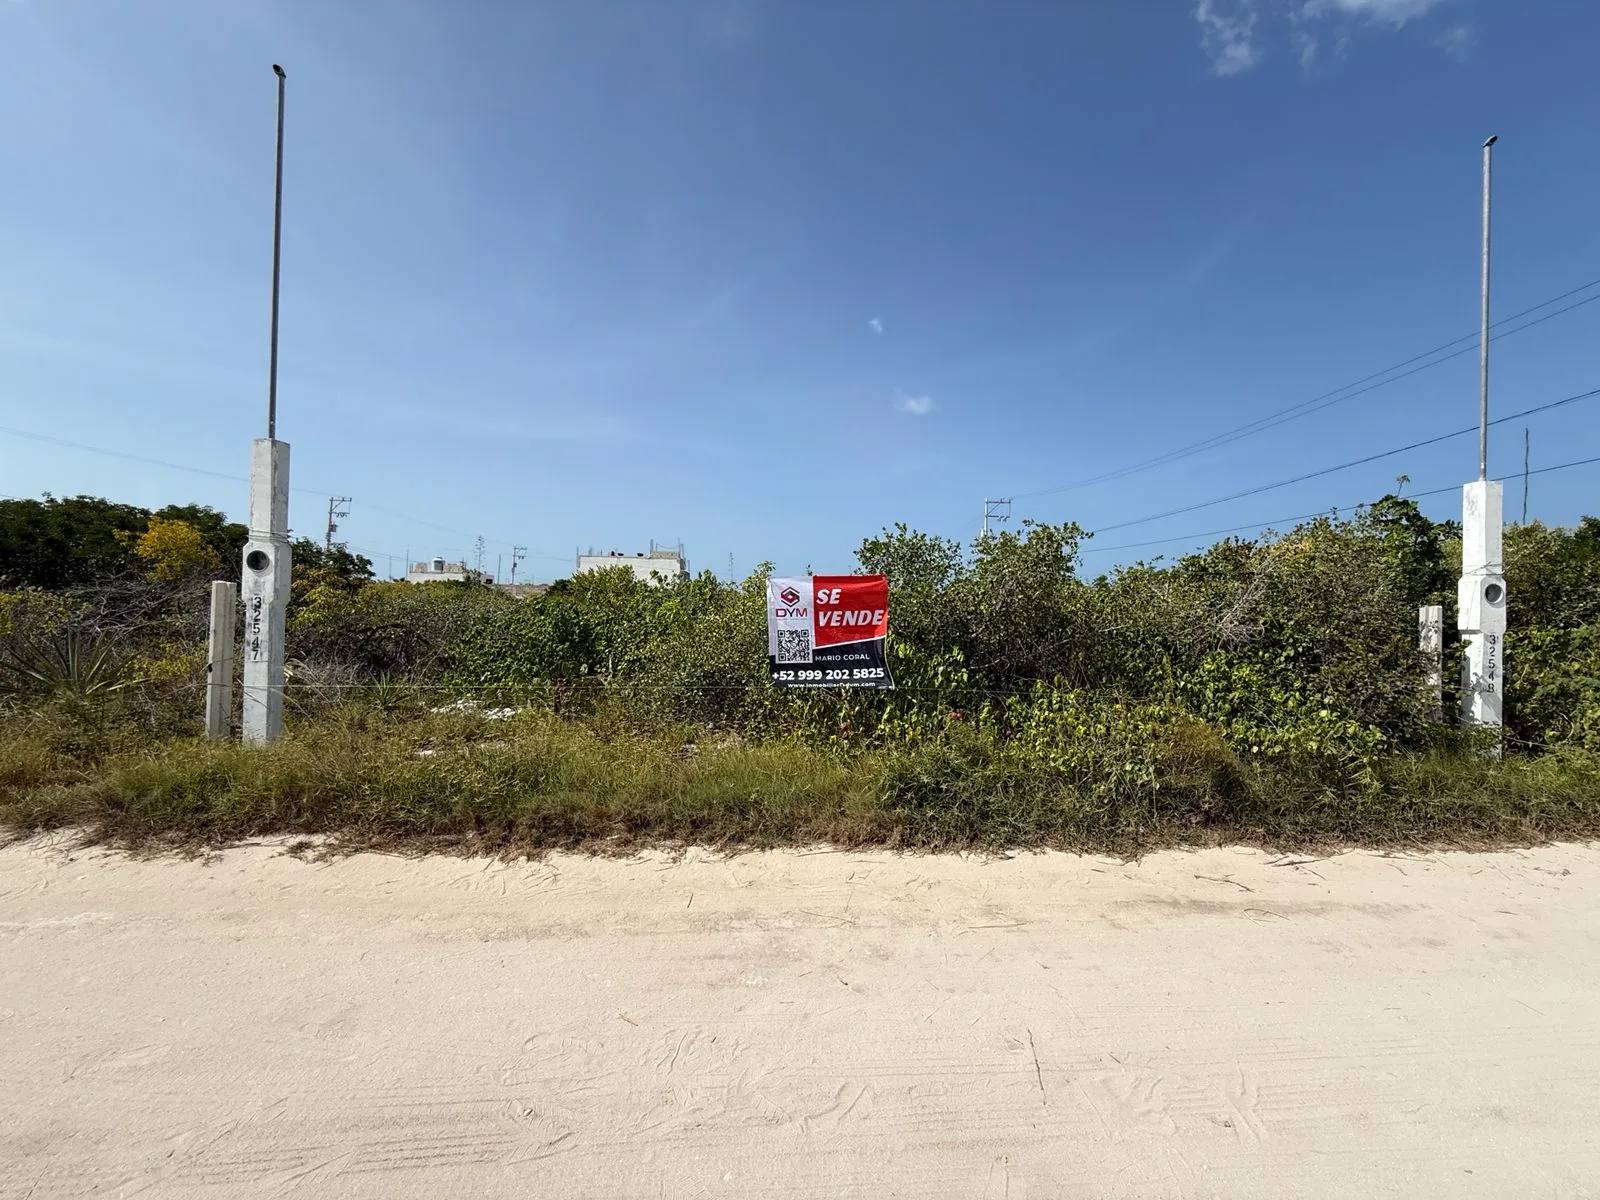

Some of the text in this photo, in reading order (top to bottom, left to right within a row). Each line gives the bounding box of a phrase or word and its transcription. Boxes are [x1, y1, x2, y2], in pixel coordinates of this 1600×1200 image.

[816, 588, 842, 605] SE
[775, 607, 808, 618] DYM
[818, 609, 884, 627] VENDE
[251, 596, 262, 660] 32547
[843, 653, 870, 661] CORAL
[1486, 634, 1497, 693] 32548
[772, 667, 885, 681] +52 999 202 5825
